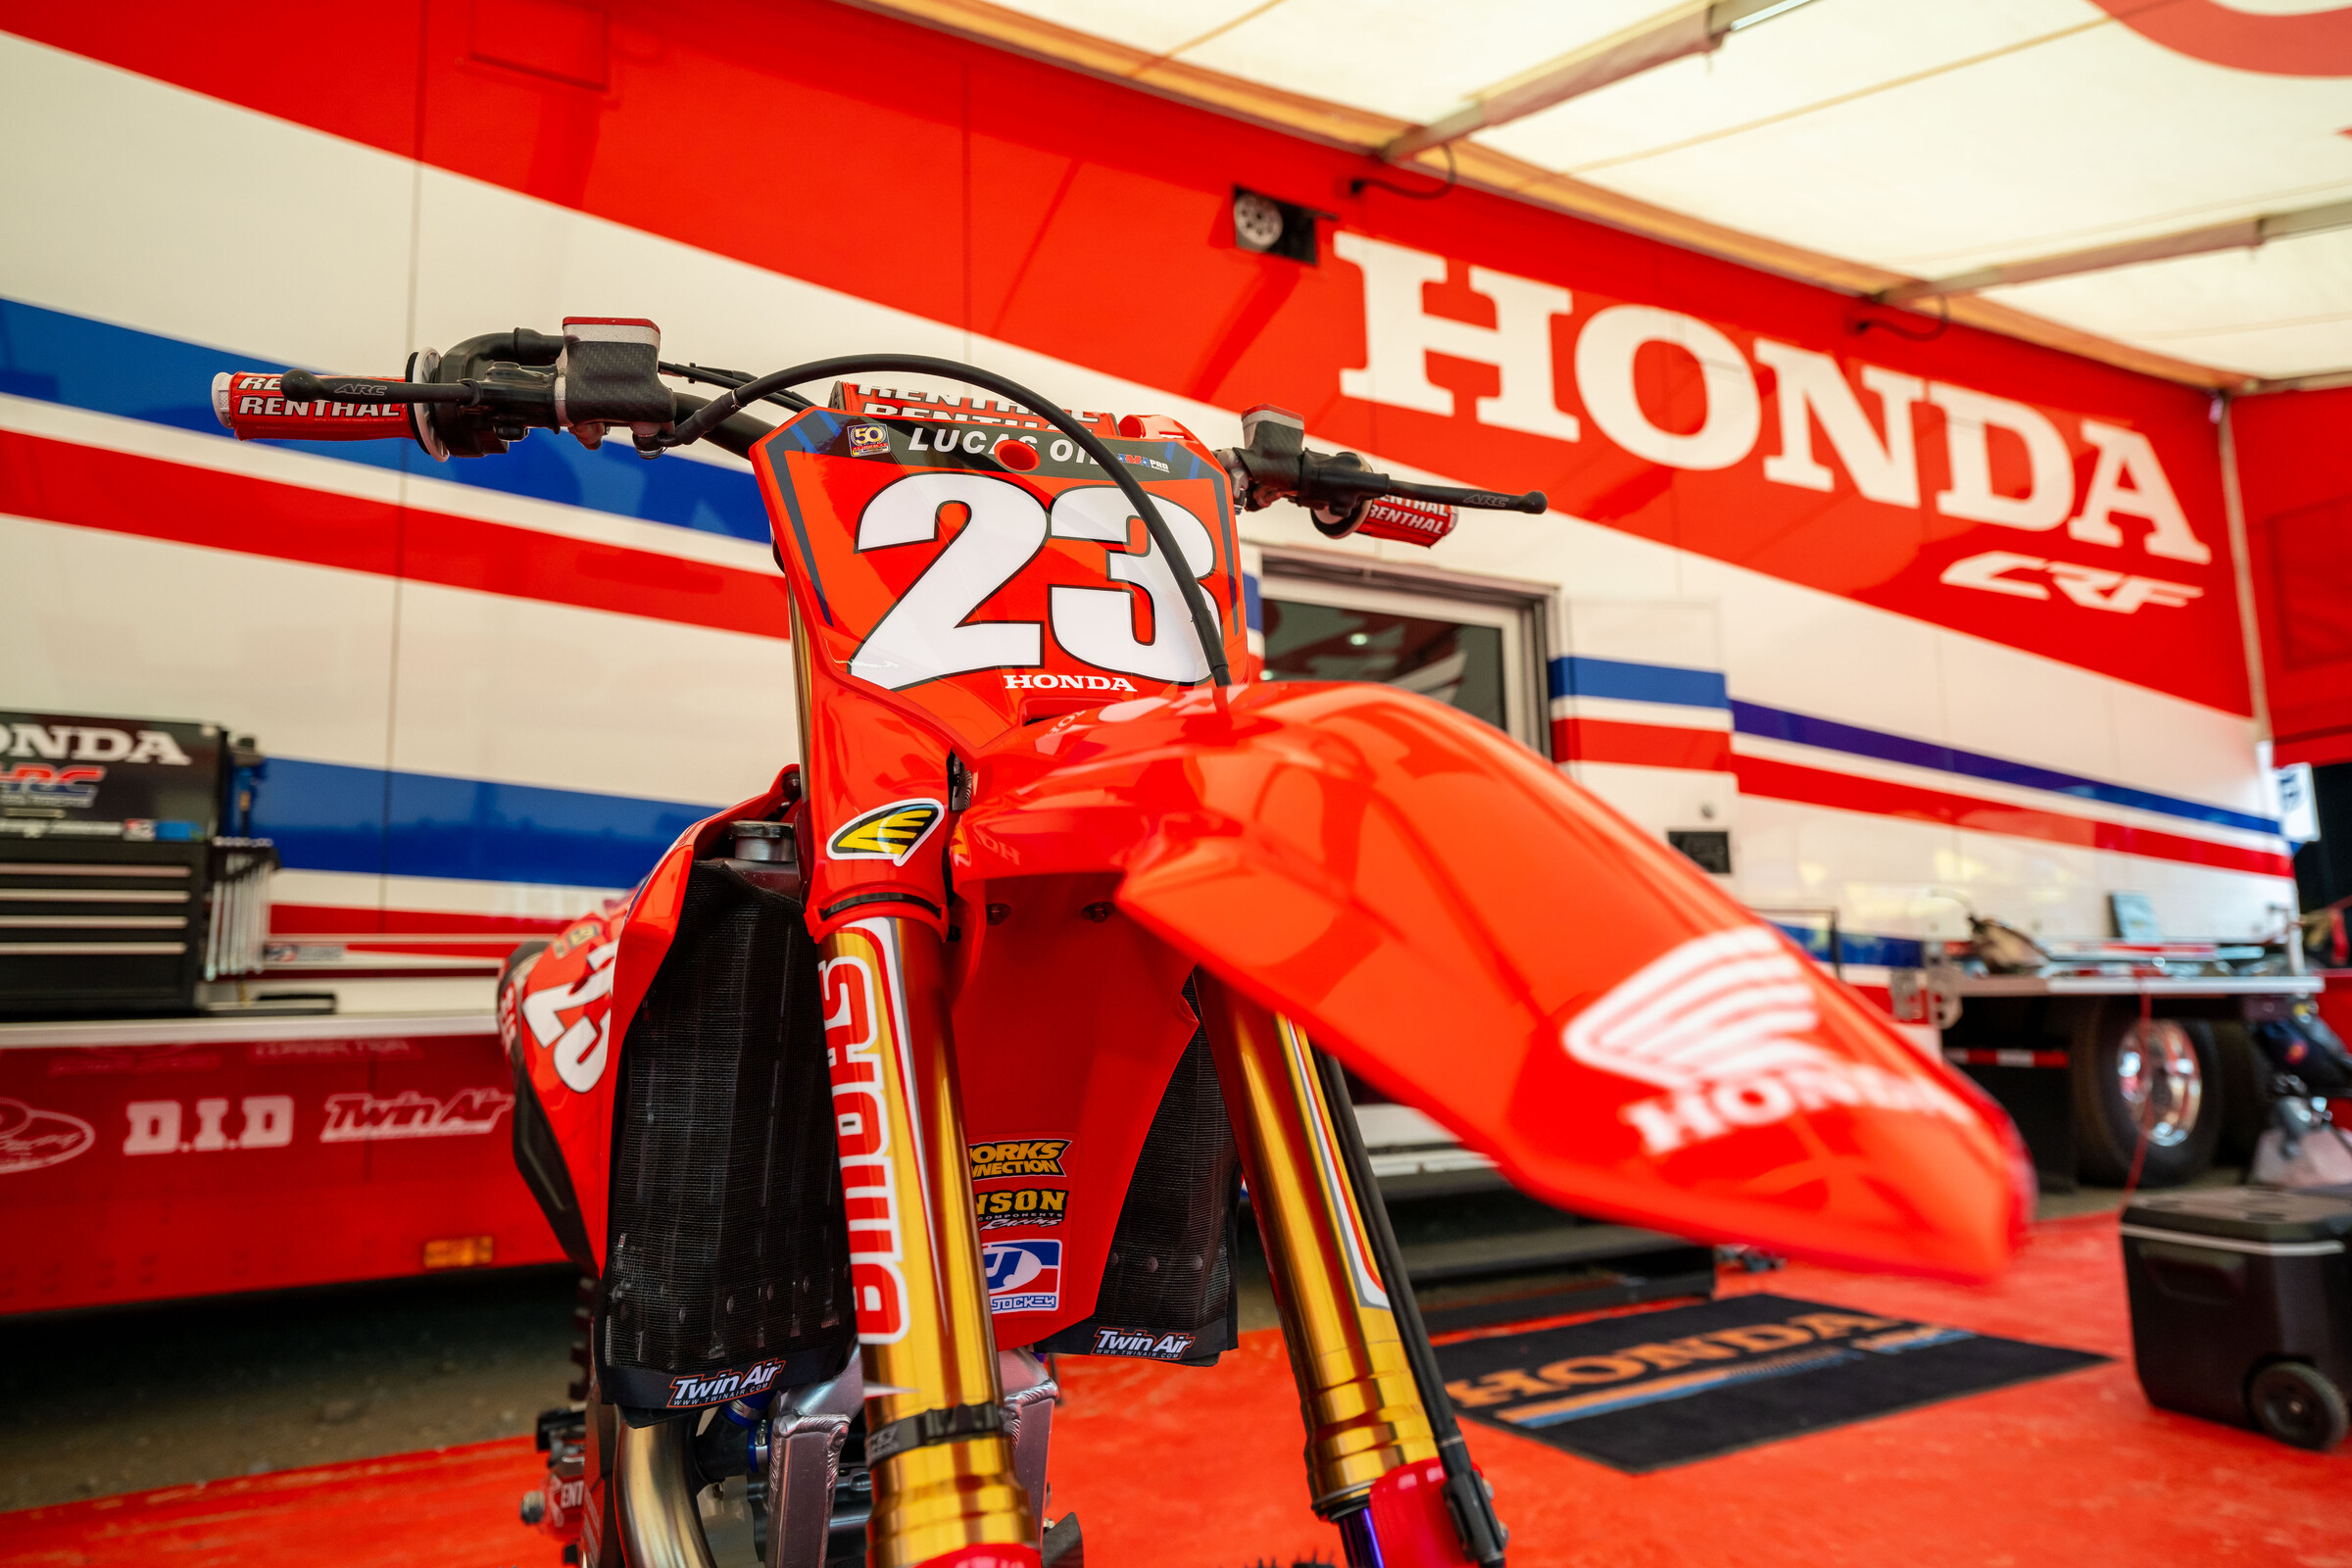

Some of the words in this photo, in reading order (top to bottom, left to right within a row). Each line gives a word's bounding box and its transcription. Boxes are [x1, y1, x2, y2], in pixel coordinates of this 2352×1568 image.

[335, 384, 387, 396] ARC
[1334, 231, 2211, 564] HONDA
[238, 396, 400, 416] RENTHAL
[855, 426, 884, 445] 50
[1117, 454, 1150, 467] AMA
[1149, 459, 1169, 470] PRO
[1463, 494, 1509, 507] ARC
[848, 470, 1224, 691] 23
[1939, 550, 2205, 614] CRF
[1003, 673, 1138, 693] HONDA
[122, 1095, 294, 1155] D.I.D
[969, 1142, 1065, 1164] ORKS
[1098, 1330, 1153, 1351] Twin
[1152, 1335, 1193, 1354] Air
[1445, 1311, 1908, 1408] HONDA
[675, 1374, 741, 1399] Twin
[740, 1362, 782, 1390] Air
[672, 1382, 769, 1406] WWW.TWINAIR.COM
